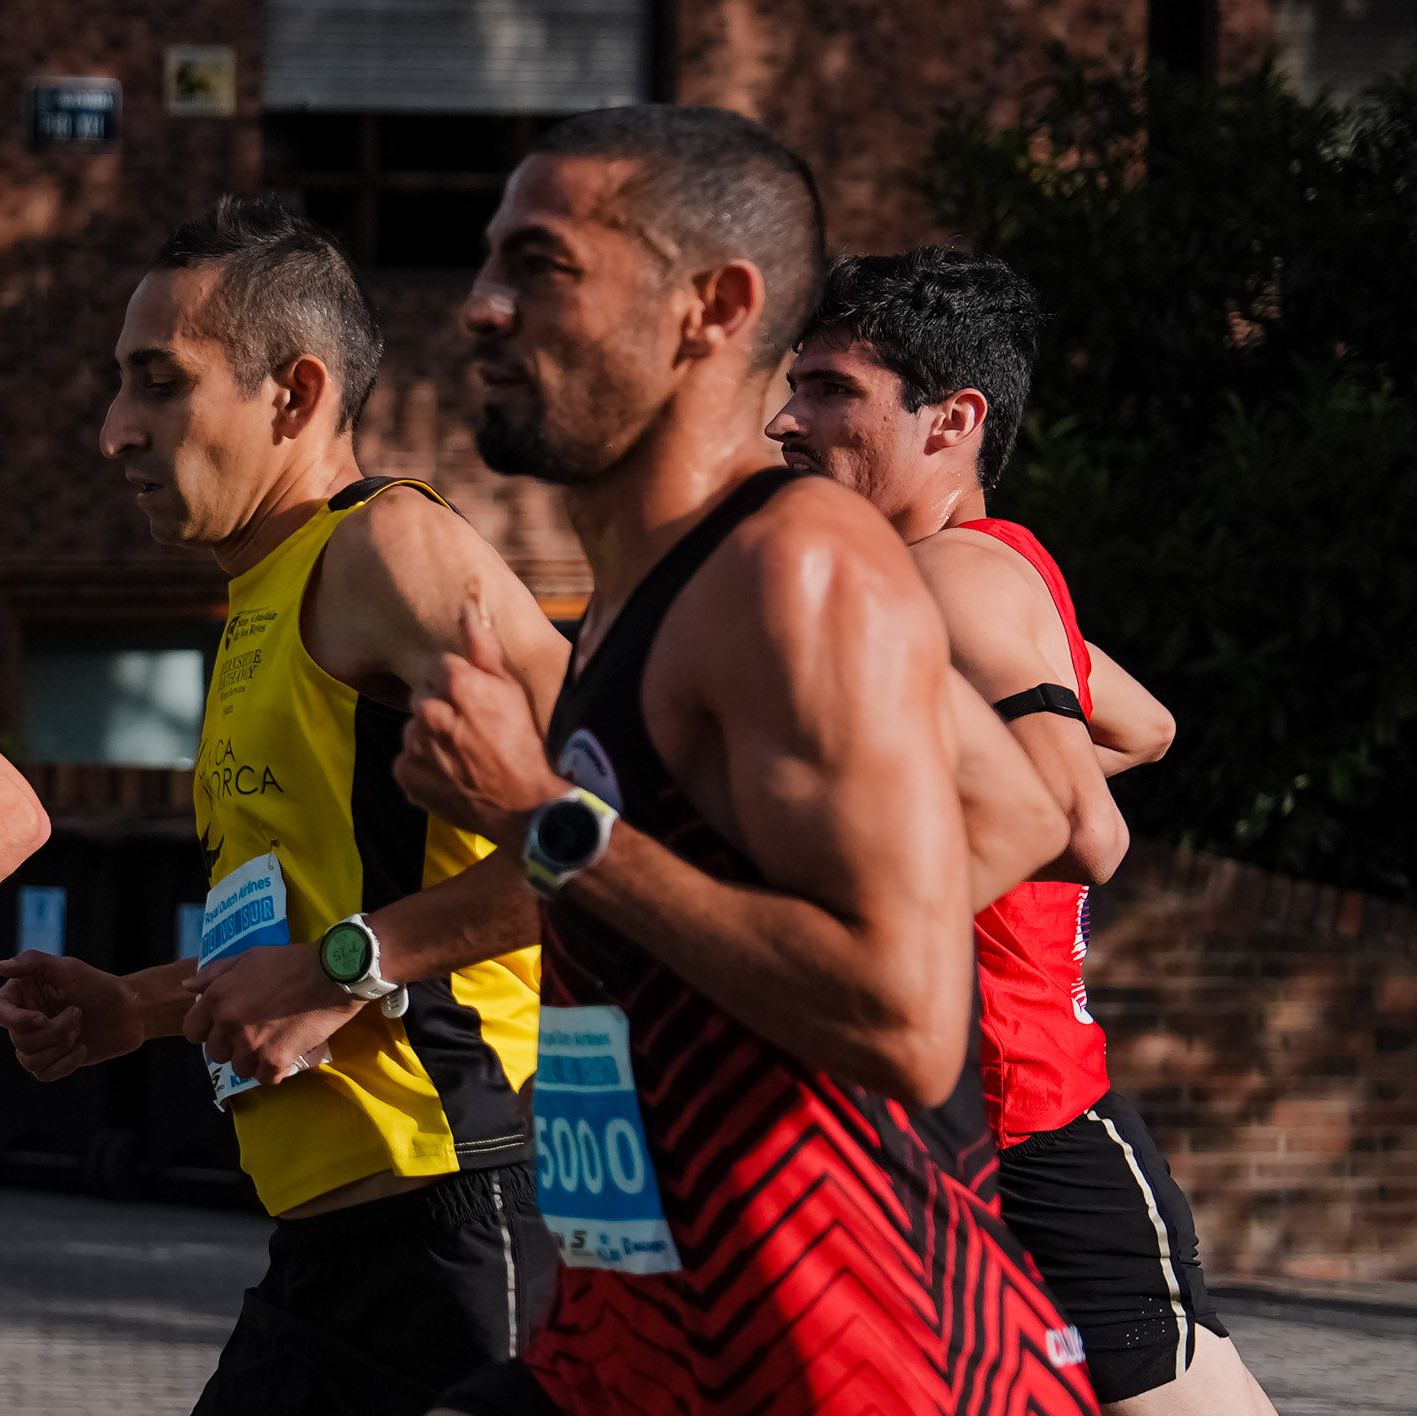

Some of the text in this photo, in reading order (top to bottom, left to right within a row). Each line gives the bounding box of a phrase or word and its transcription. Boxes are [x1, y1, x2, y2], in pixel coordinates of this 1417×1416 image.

[238, 877, 272, 900] Airlines
[242, 896, 274, 930] SUR
[534, 1115, 645, 1194] 5000
